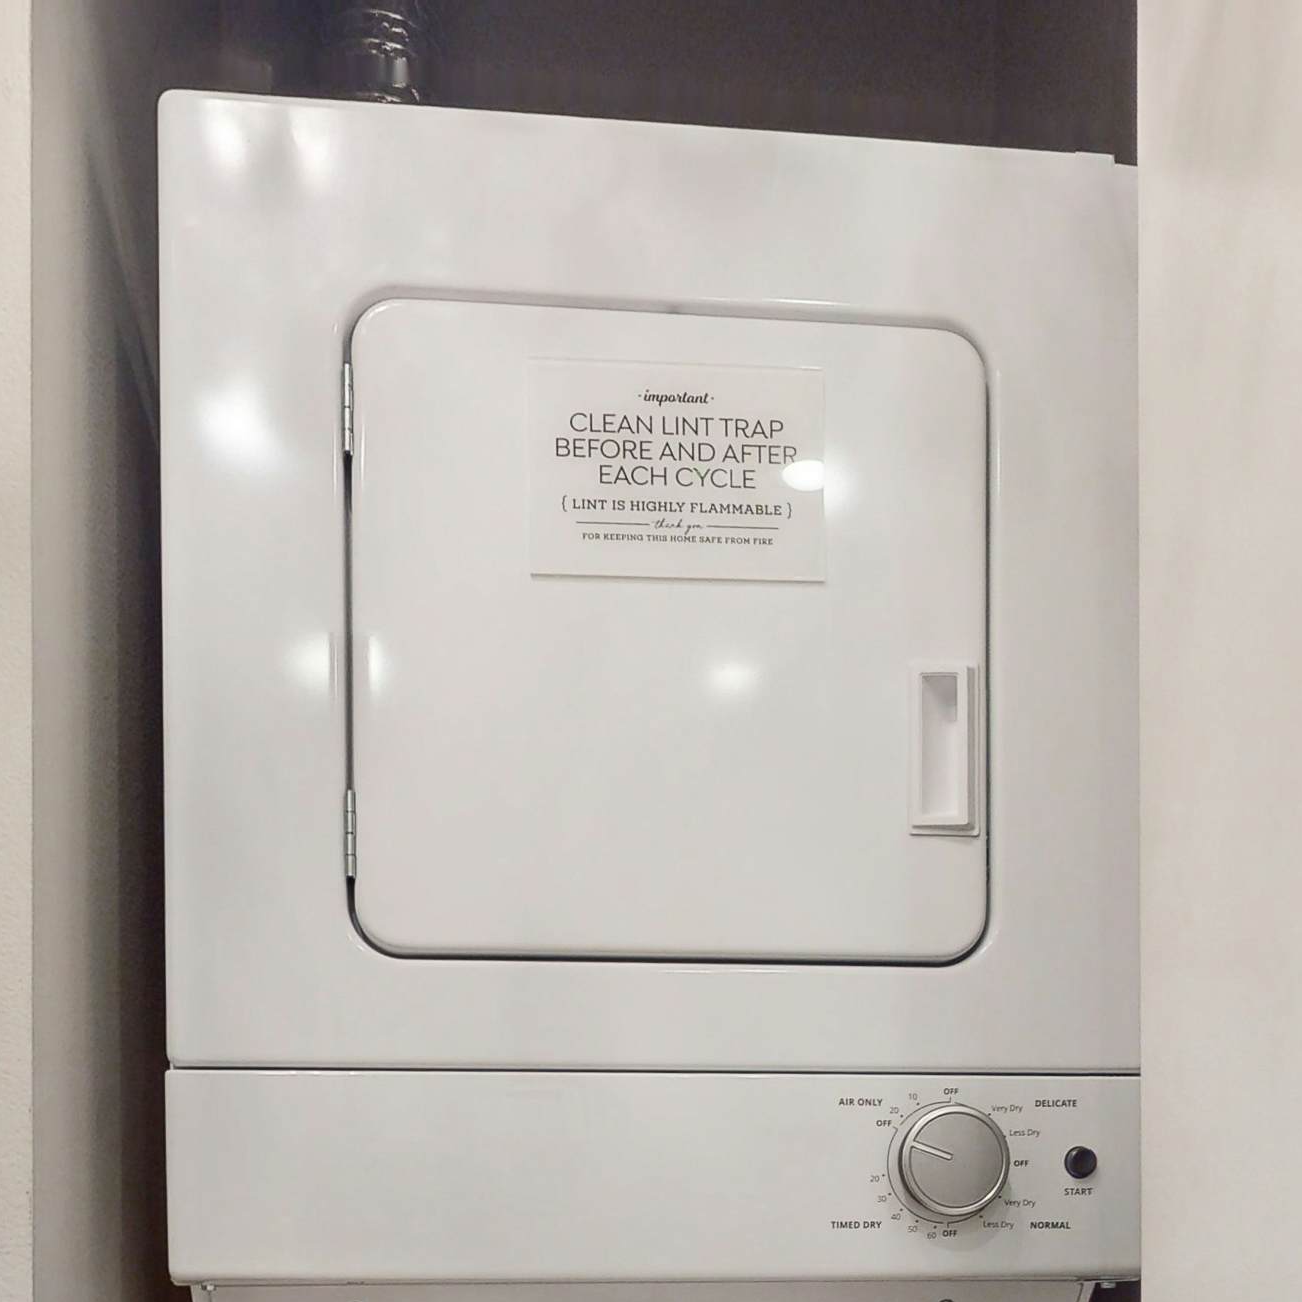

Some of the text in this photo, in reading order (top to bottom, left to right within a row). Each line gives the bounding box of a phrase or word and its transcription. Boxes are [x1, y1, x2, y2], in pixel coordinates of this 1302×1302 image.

[569, 412, 784, 440] CLEAN LINT TRAP
[555, 438, 798, 465] BEFORE AND AFTER
[599, 465, 756, 489] EACH CYCLE
[612, 499, 626, 511] IS
[630, 500, 686, 513] HIGHLY
[582, 532, 774, 546] FOR KEEPING THIS HOME SAFE FROM FIRE
[908, 1093, 918, 1101] 10
[838, 1098, 883, 1107] AIR ONLY
[1034, 1099, 1078, 1108] DELICATE
[889, 1106, 899, 1114] 20
[991, 1104, 1024, 1113] Very Dry
[876, 1119, 892, 1127] OFF
[1009, 1129, 1041, 1138] Less Dry
[1013, 1159, 1029, 1167] OFF
[870, 1175, 880, 1183] 20
[1064, 1187, 1093, 1196] START
[877, 1195, 887, 1203] 30
[1004, 1199, 1036, 1209] Very Dry
[831, 1220, 882, 1229] TIMED DRY
[907, 1225, 918, 1233] 50
[982, 1220, 1015, 1230] Less Dry
[1029, 1221, 1072, 1230] NORMAL
[927, 1232, 937, 1240] 60
[942, 1229, 958, 1238] OFF
